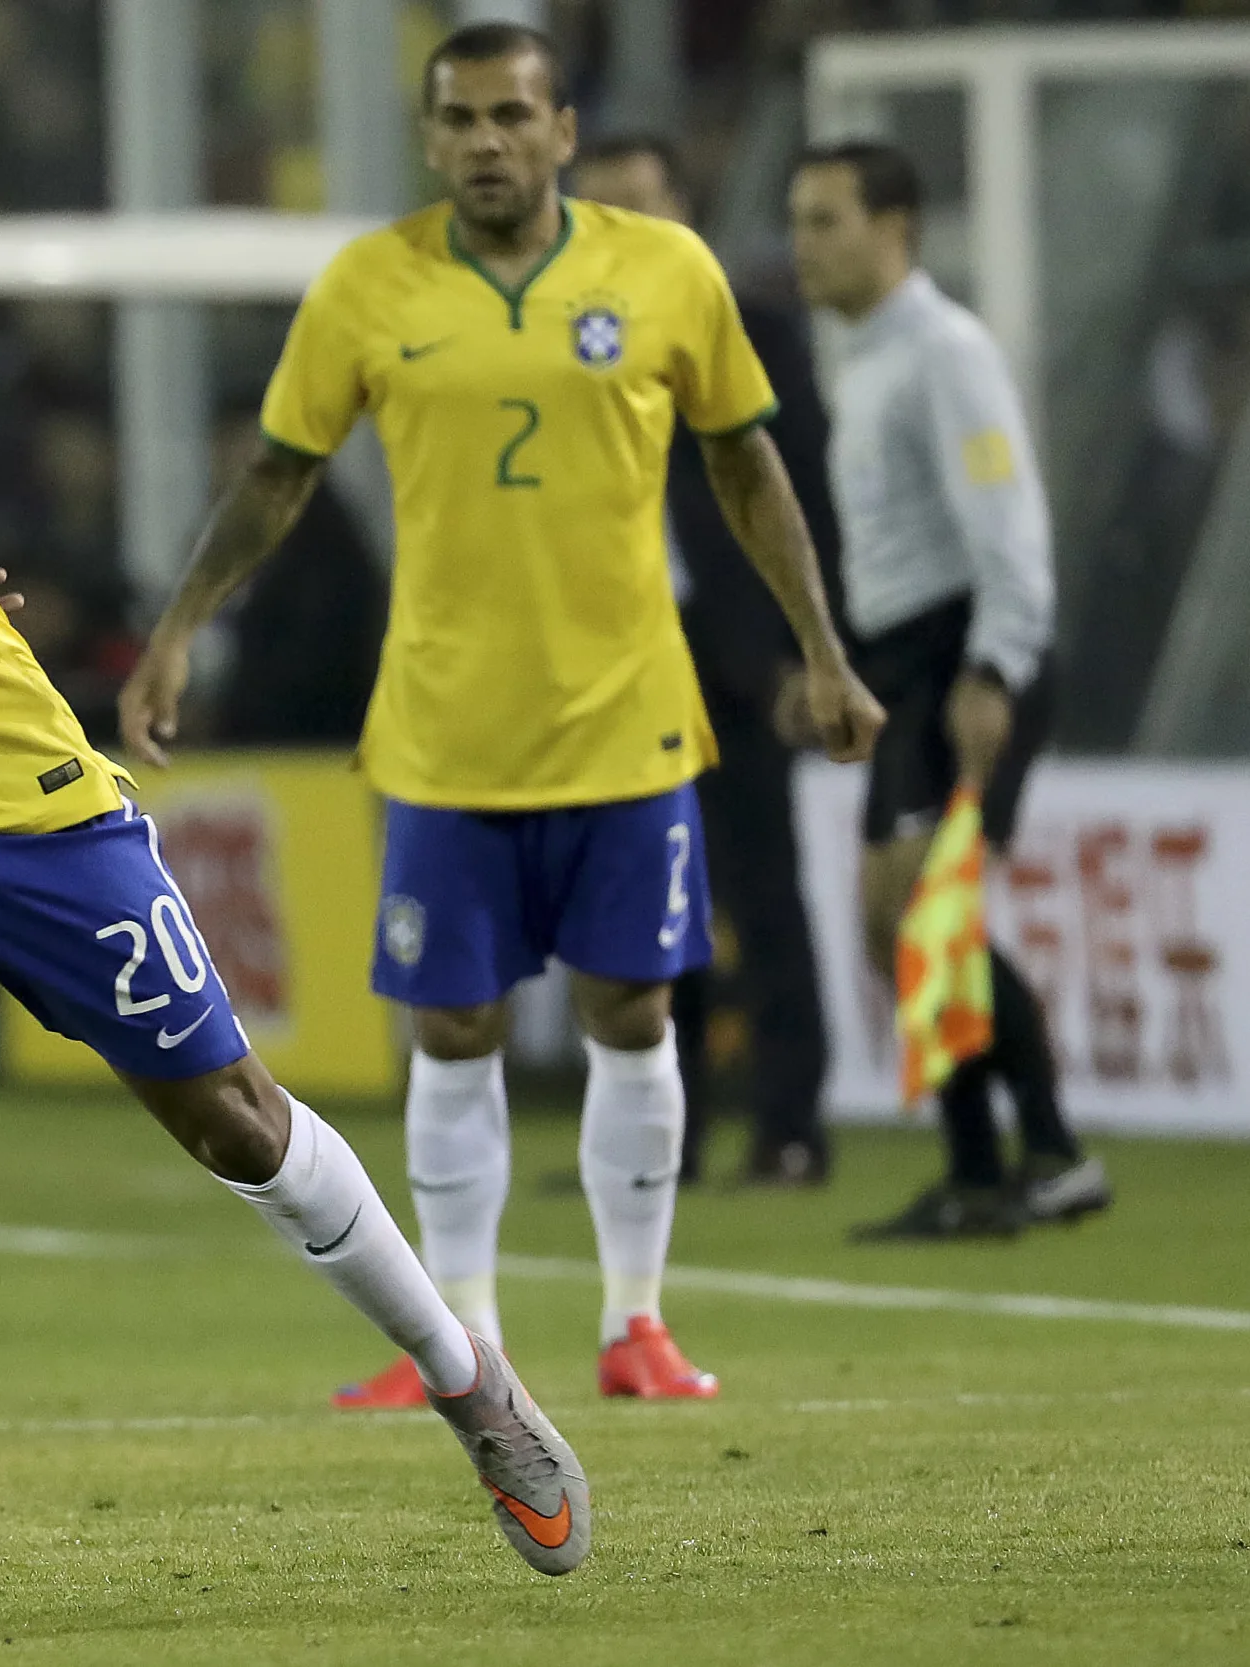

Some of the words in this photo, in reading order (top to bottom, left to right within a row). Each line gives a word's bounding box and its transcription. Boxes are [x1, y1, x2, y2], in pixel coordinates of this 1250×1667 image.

[497, 398, 541, 488] 2
[666, 822, 691, 915] 2
[96, 895, 207, 1016] 20
